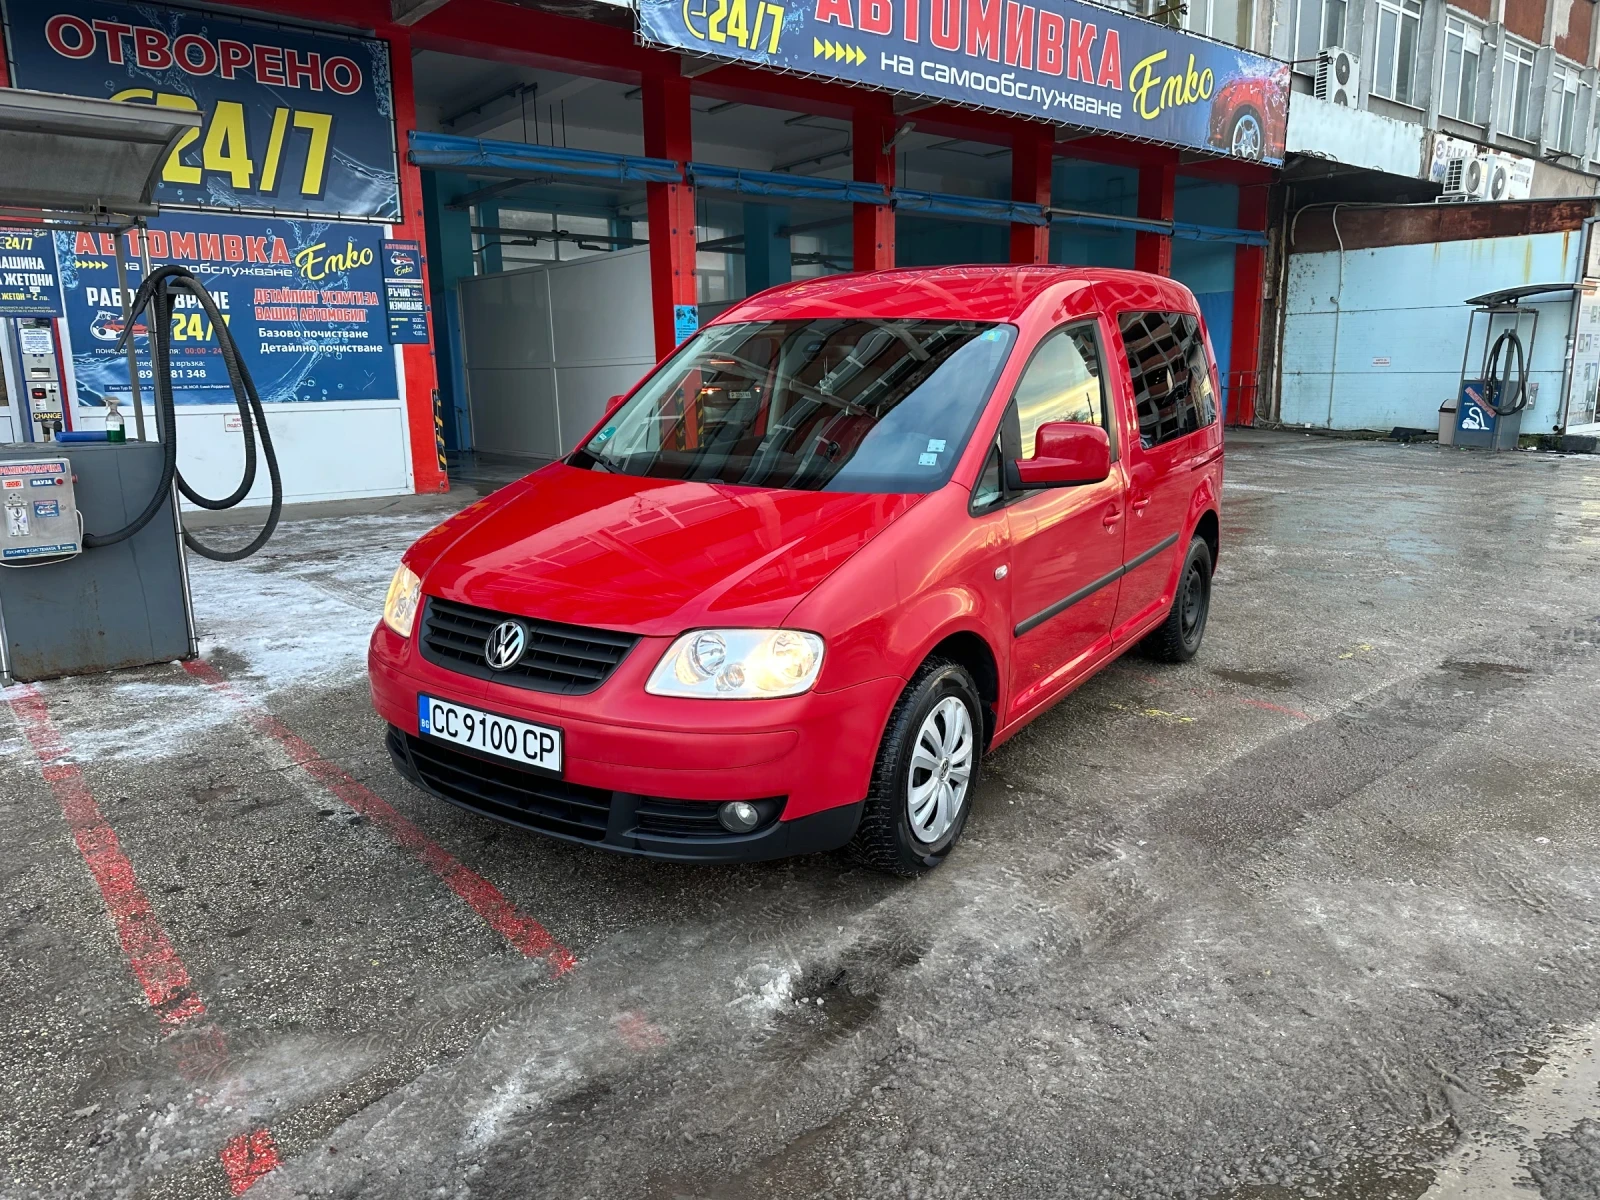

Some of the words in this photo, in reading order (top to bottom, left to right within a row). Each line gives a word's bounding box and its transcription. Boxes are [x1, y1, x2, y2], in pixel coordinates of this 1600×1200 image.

[708, 0, 785, 54] 24/7
[45, 14, 363, 96] ОТВОРЕНО
[881, 52, 914, 76] на
[920, 61, 1122, 119] самообслужване
[156, 92, 333, 195] 24/7
[4, 236, 33, 250] 24/7
[0, 256, 45, 270] АШИНА
[3, 272, 54, 287] ЖЕТОНИ
[1, 292, 26, 301] ЖЕТОН
[254, 287, 319, 304] ДЕТАЙЛИНГ
[322, 291, 364, 305] УСЛУГИ
[364, 292, 379, 305] ЗА
[388, 287, 410, 297] РЪЧНО
[389, 301, 423, 311] ИЗМИВАНЕ
[255, 307, 298, 321] ВАШИЯ
[299, 308, 367, 322] АВТОМОБИЛ
[258, 328, 301, 338] Базово
[303, 329, 369, 339] почистване
[184, 347, 207, 355] 00:00
[260, 343, 317, 354] Детайлно
[319, 343, 383, 353] почистване
[186, 369, 207, 378] 348
[421, 718, 430, 729] BG
[432, 704, 459, 738] CC
[463, 713, 517, 754] 9100
[523, 729, 555, 762] CP
